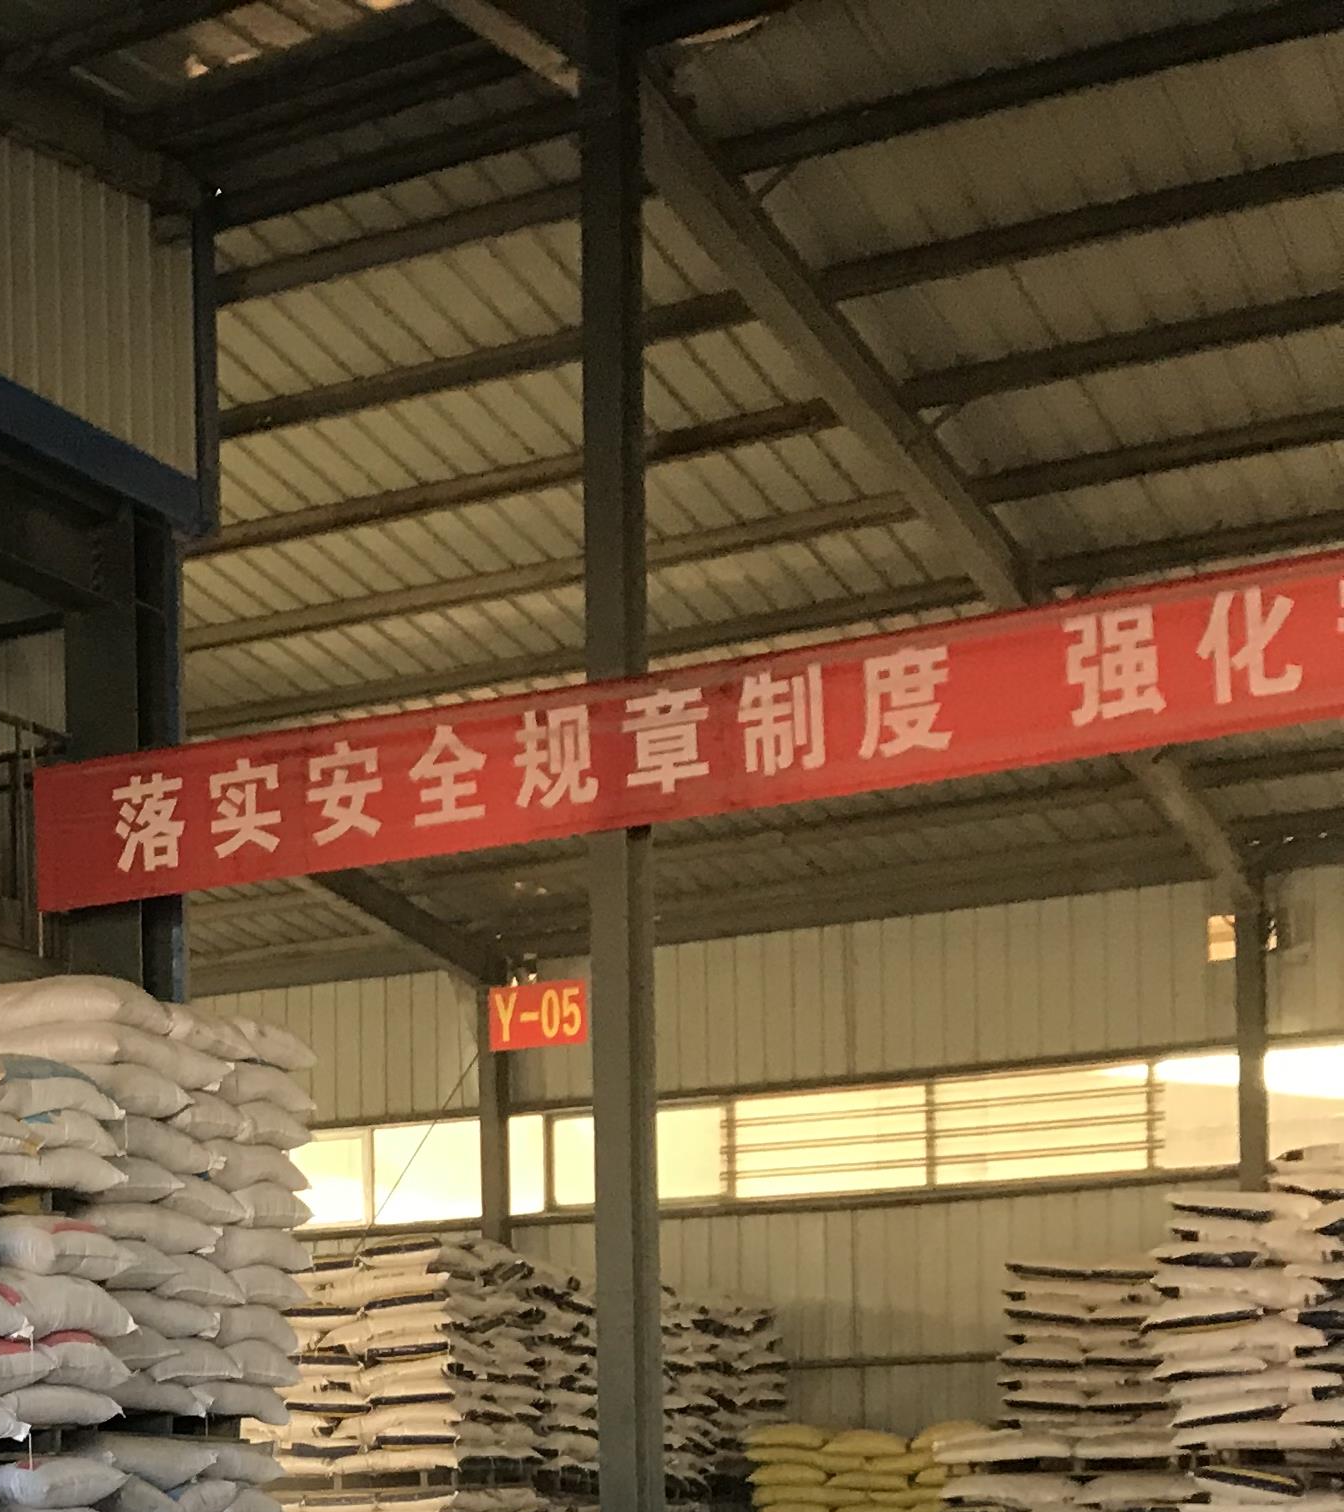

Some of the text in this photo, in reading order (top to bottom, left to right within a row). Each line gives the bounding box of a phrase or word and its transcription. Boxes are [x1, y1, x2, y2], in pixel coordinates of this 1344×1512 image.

[110, 586, 1344, 873] 落实安全规章制度 强化
[494, 986, 582, 1042] Y-05
